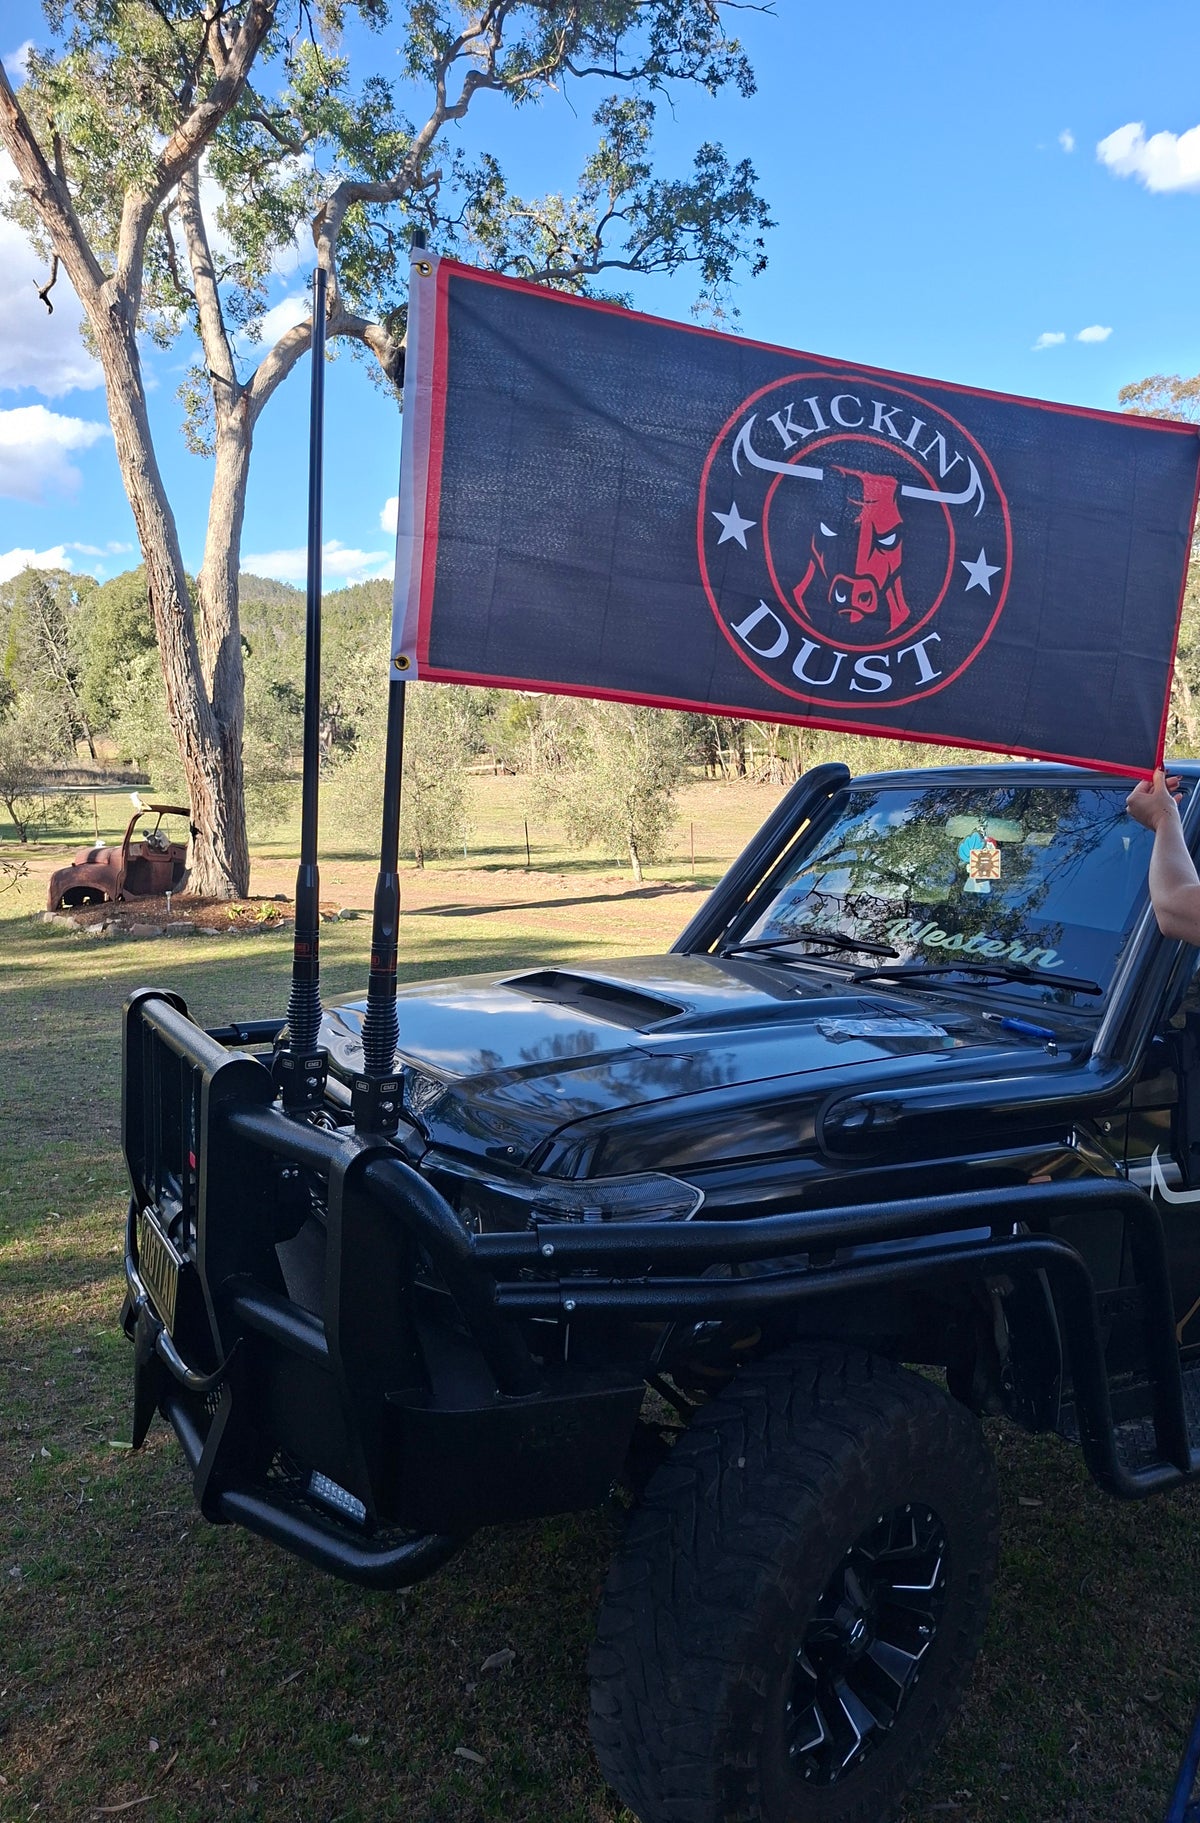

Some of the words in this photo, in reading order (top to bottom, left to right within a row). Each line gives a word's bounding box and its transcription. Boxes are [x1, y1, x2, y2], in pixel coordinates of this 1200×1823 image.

[767, 394, 963, 478] KICKIN
[730, 599, 942, 693] DUST
[886, 918, 1064, 968] Western
